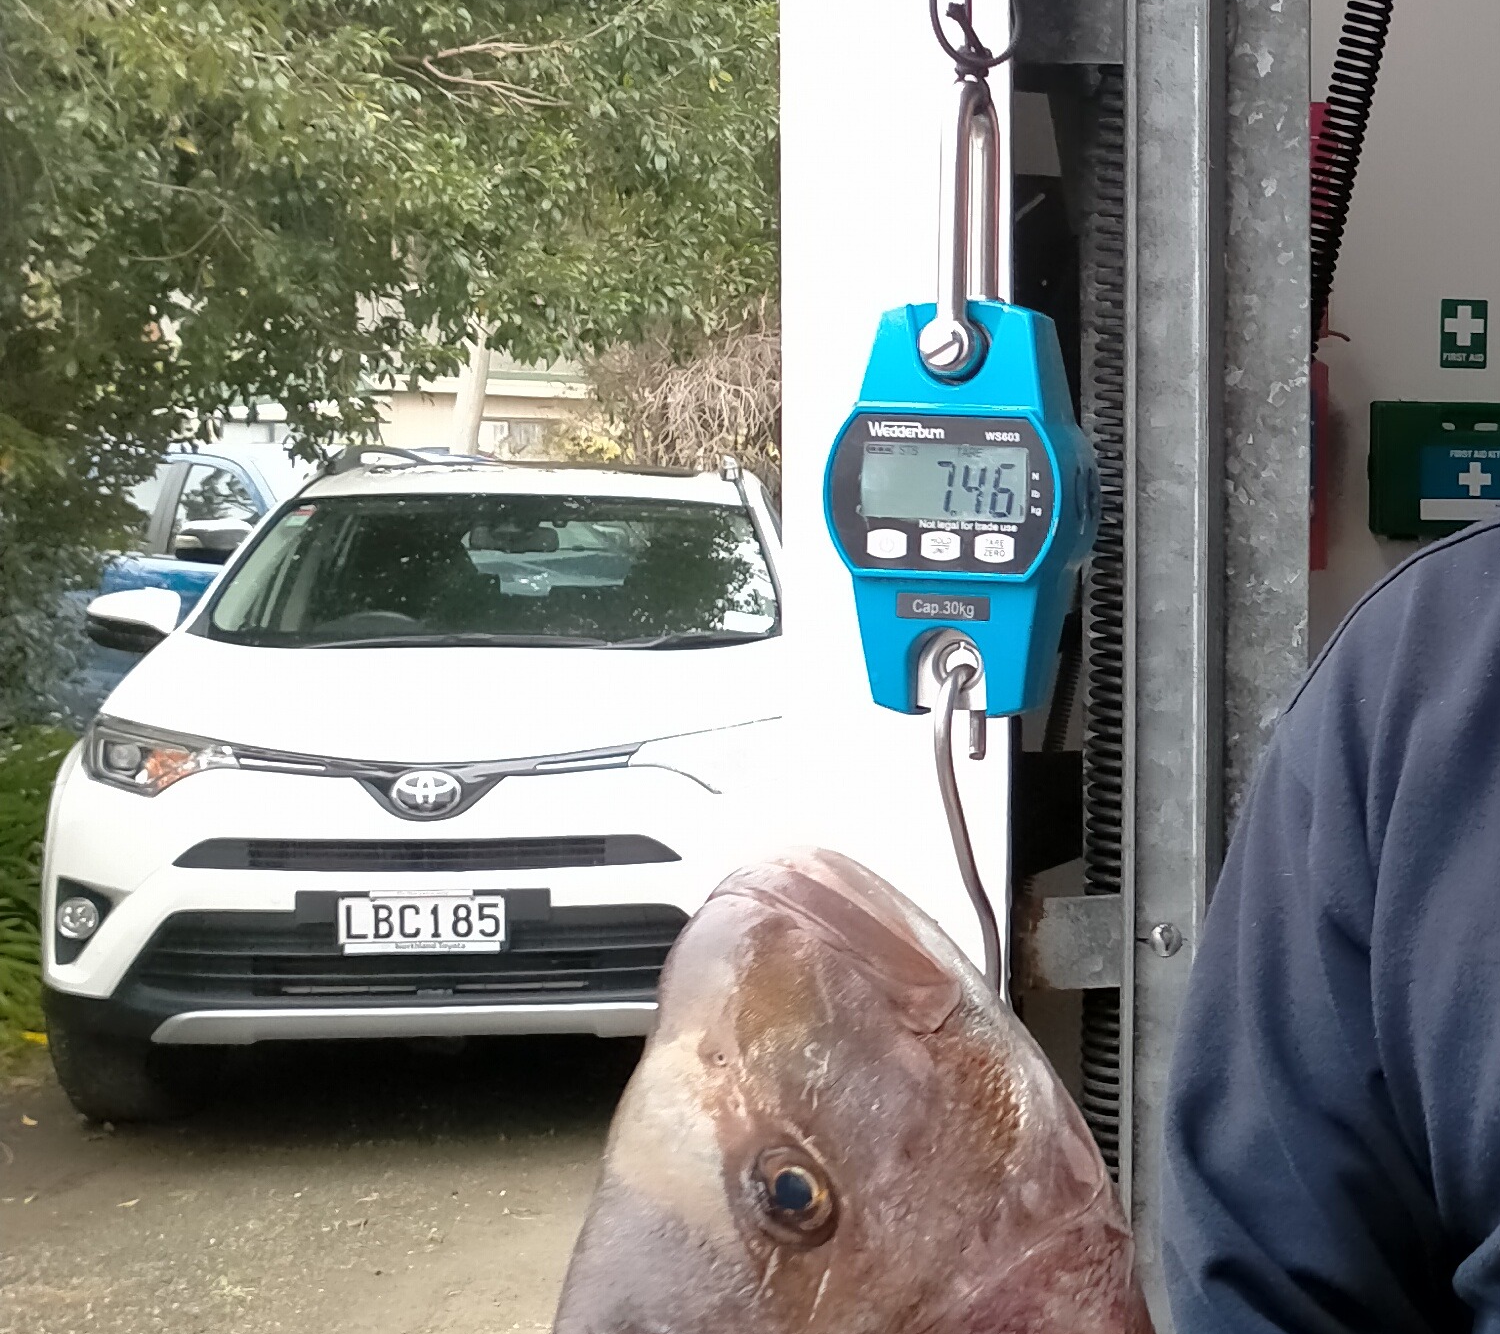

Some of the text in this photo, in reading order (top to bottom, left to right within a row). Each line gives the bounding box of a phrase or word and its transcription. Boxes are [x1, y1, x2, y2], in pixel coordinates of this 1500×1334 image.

[1442, 352, 1485, 363] FIRST AID
[867, 421, 946, 439] Wedderburn
[1449, 449, 1500, 459] FIRST AID KIT
[1031, 472, 1040, 481] N
[937, 460, 1017, 518] 7.46
[1030, 505, 1043, 517] kg
[918, 519, 1018, 533] Not legal for trade use
[983, 549, 1006, 558] ZERO
[912, 598, 975, 619] Cap.30kg
[345, 902, 501, 940] LBC185
